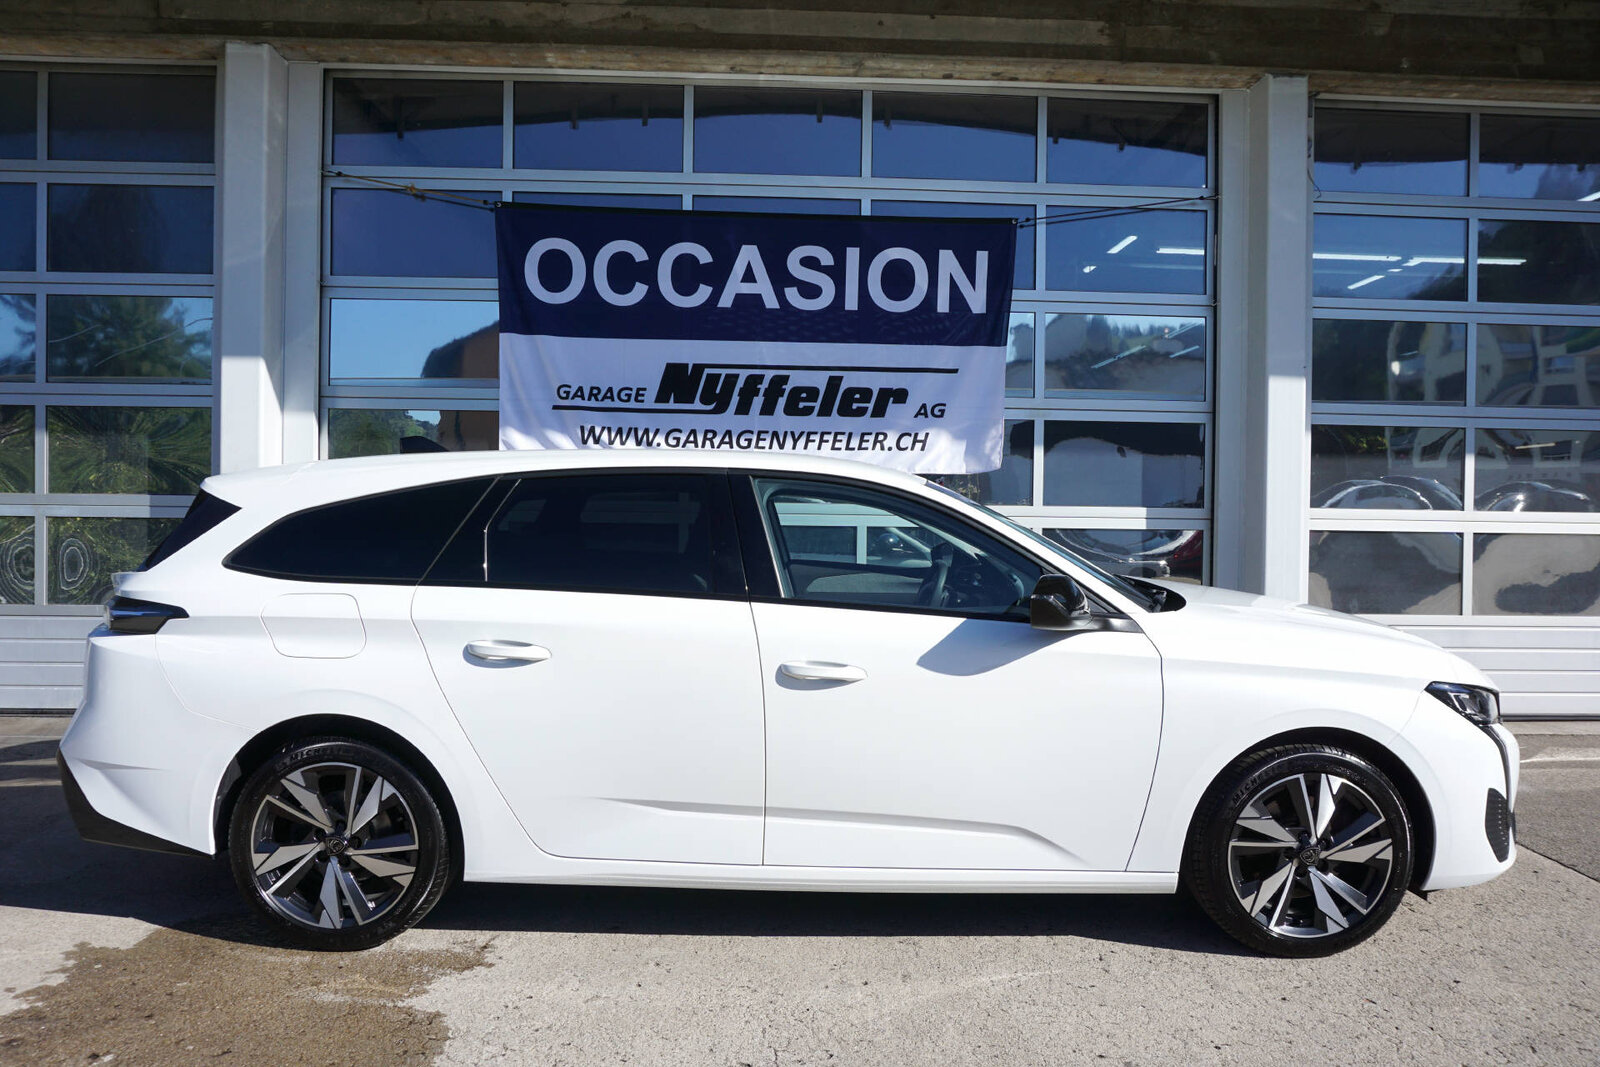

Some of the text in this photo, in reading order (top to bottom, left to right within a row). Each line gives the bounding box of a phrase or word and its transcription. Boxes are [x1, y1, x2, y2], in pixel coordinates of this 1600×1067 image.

[524, 237, 989, 314] OCCASION
[556, 362, 947, 419] GARAGE Nyffeler AG
[579, 425, 930, 451] WWW.GARAGENYFFELER.CH
